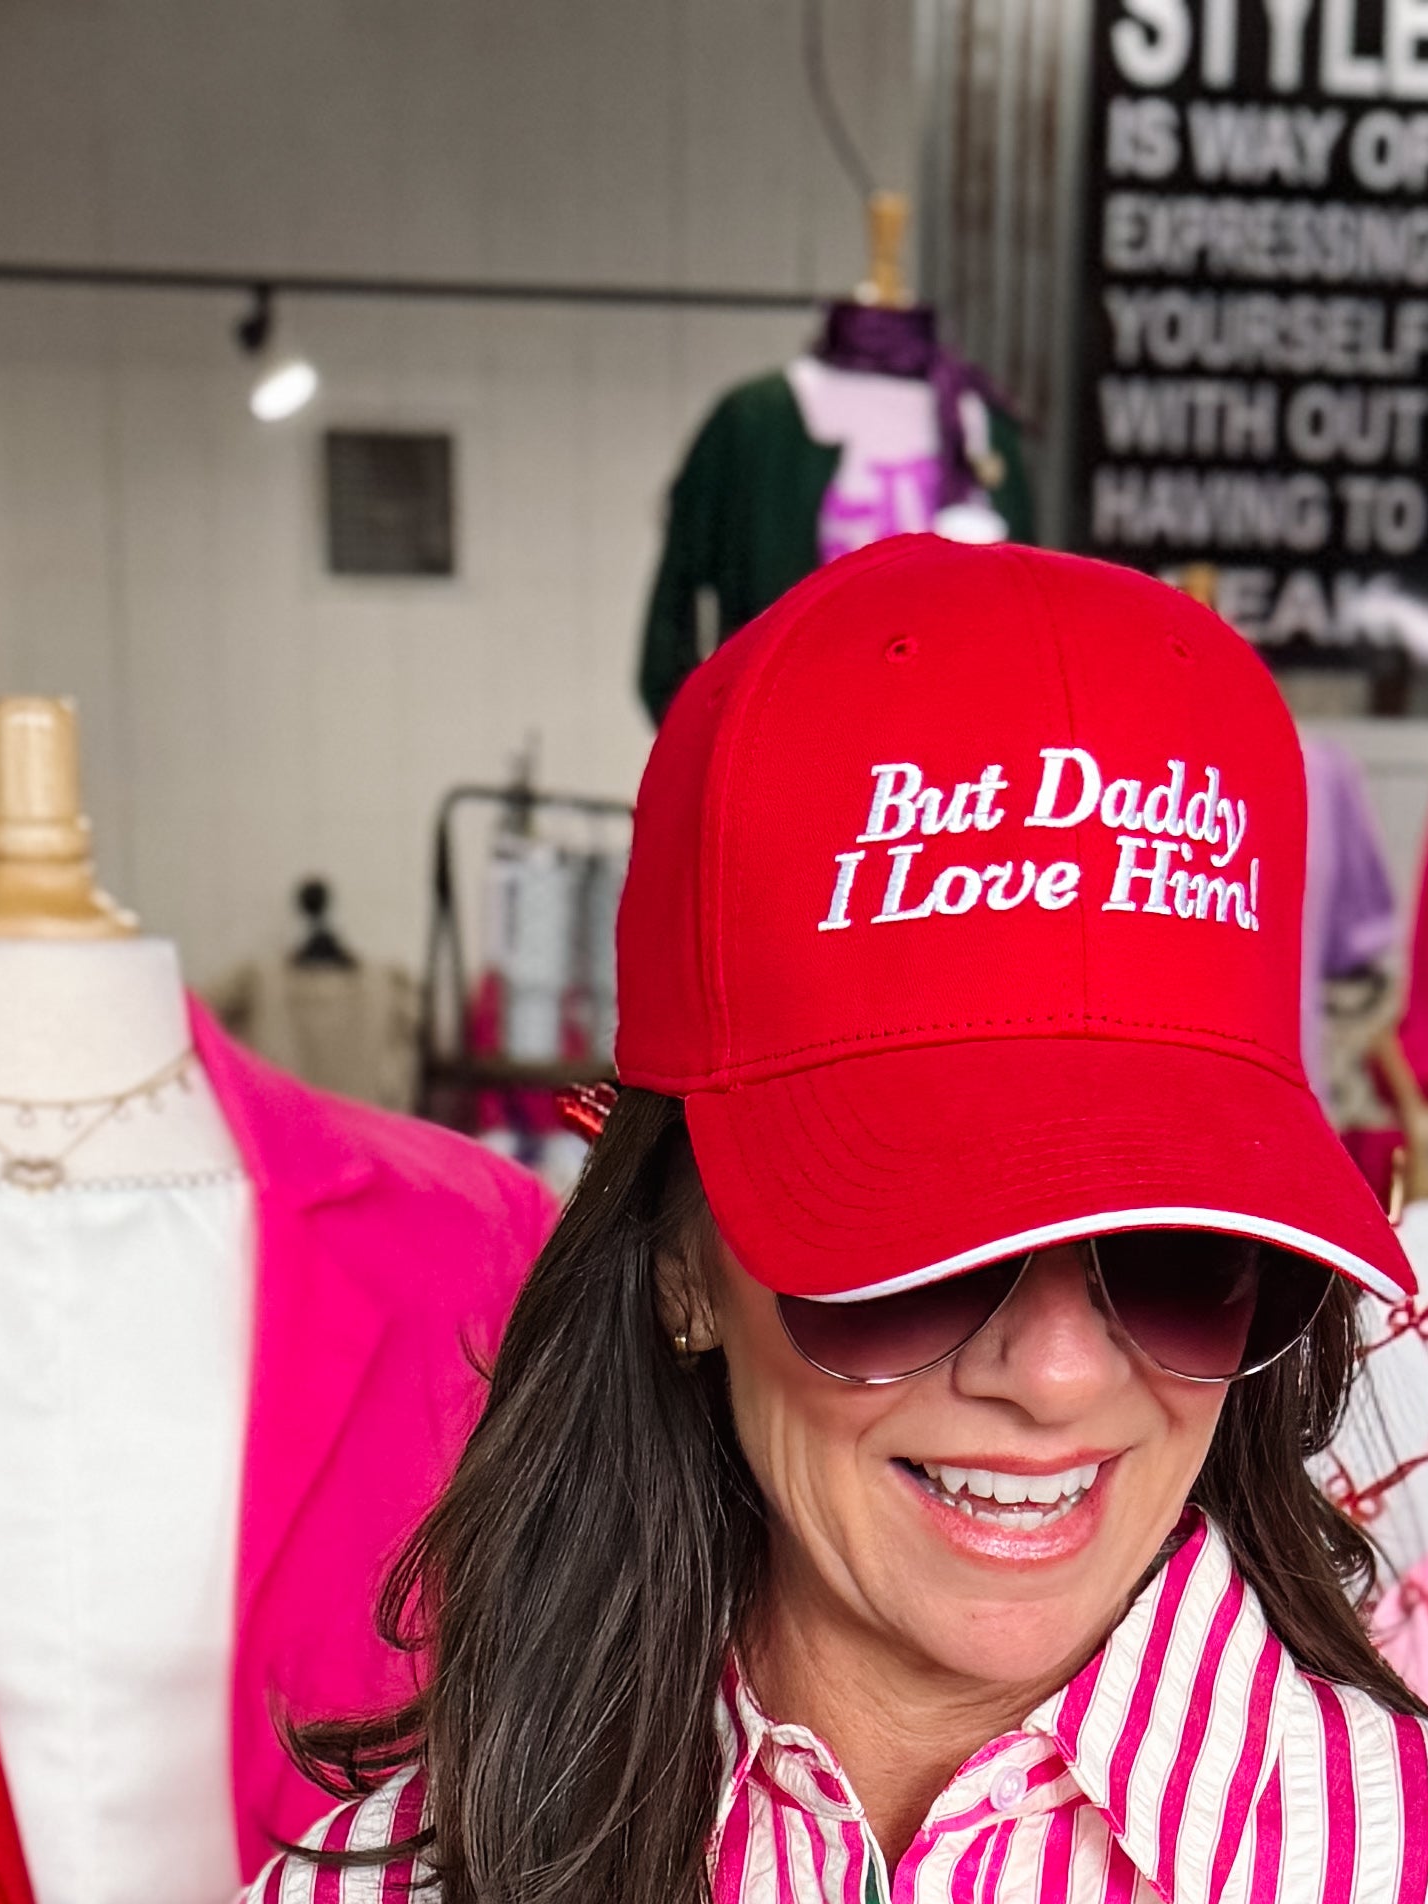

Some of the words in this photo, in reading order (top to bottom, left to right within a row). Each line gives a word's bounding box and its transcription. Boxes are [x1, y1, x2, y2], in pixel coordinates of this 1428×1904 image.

[1106, 97, 1180, 180] IS
[1187, 101, 1346, 188] WAY
[1098, 379, 1278, 458] WITH
[1091, 464, 1330, 551] HAVING
[1336, 474, 1428, 555] TO
[855, 761, 1010, 845] But
[1023, 746, 1248, 867] Daddy
[816, 850, 866, 932] I
[869, 843, 1082, 926] Love
[1101, 835, 1260, 932] Him!
